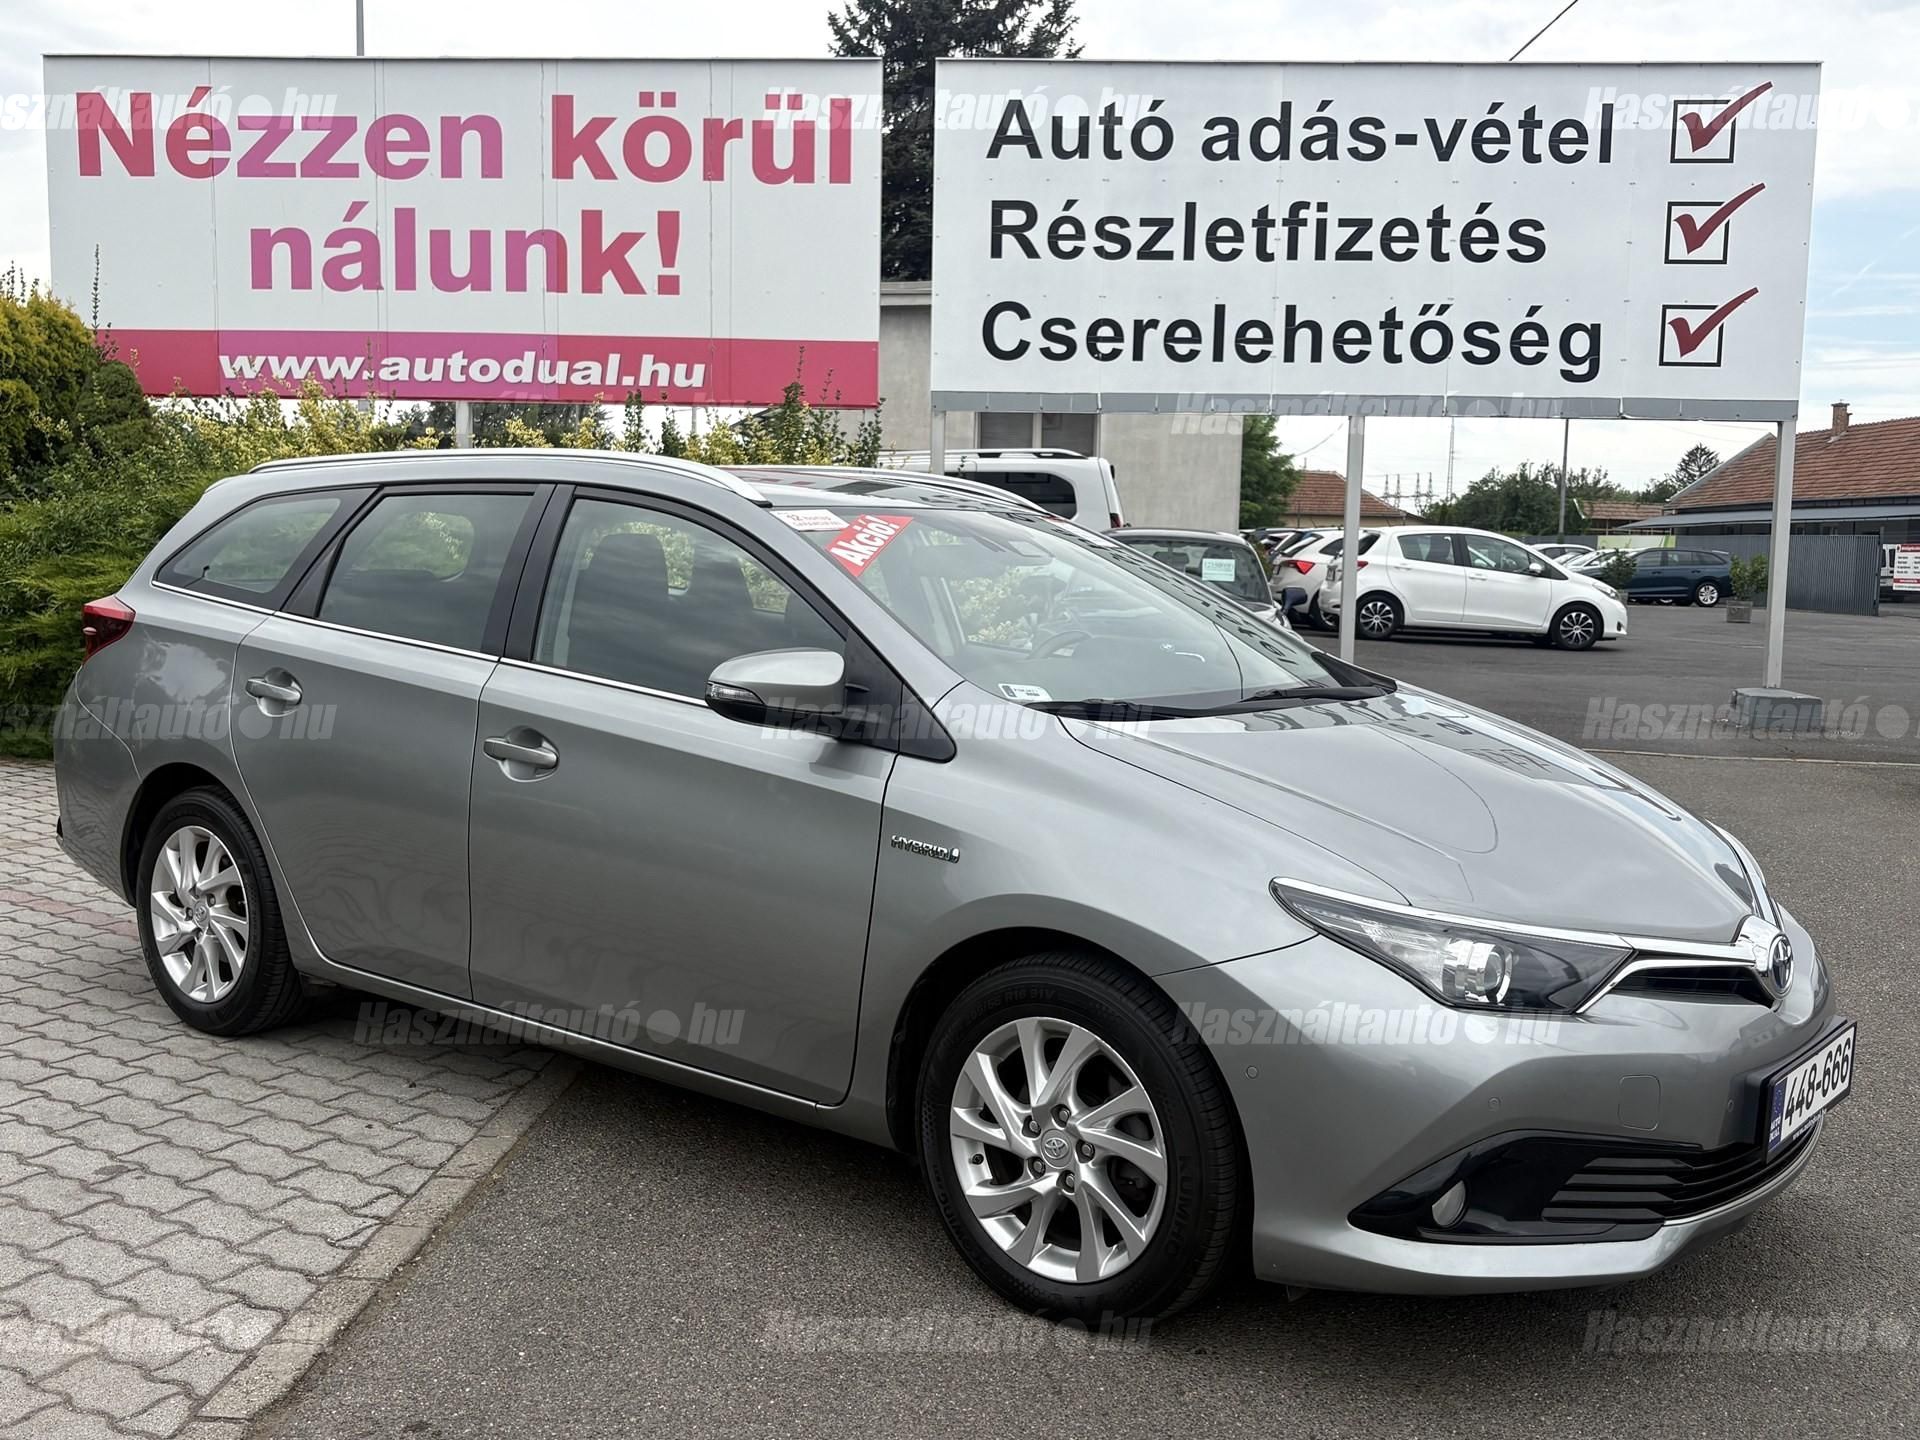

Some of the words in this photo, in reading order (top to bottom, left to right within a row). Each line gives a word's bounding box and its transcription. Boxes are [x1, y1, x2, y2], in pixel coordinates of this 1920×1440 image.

[78, 87, 502, 179] Nézzen
[552, 92, 852, 185] körül
[987, 98, 1174, 160] Autó
[1201, 98, 1613, 164] adás-vétel
[251, 202, 680, 296] nálunk!
[990, 199, 1546, 263] Részletfizetés
[220, 350, 706, 390] www.autodual.hu
[983, 301, 1601, 383] Cserelehetőség
[830, 515, 901, 567] Akció!
[890, 834, 949, 861] HYBRID
[1785, 1037, 1851, 1126] 448-666
